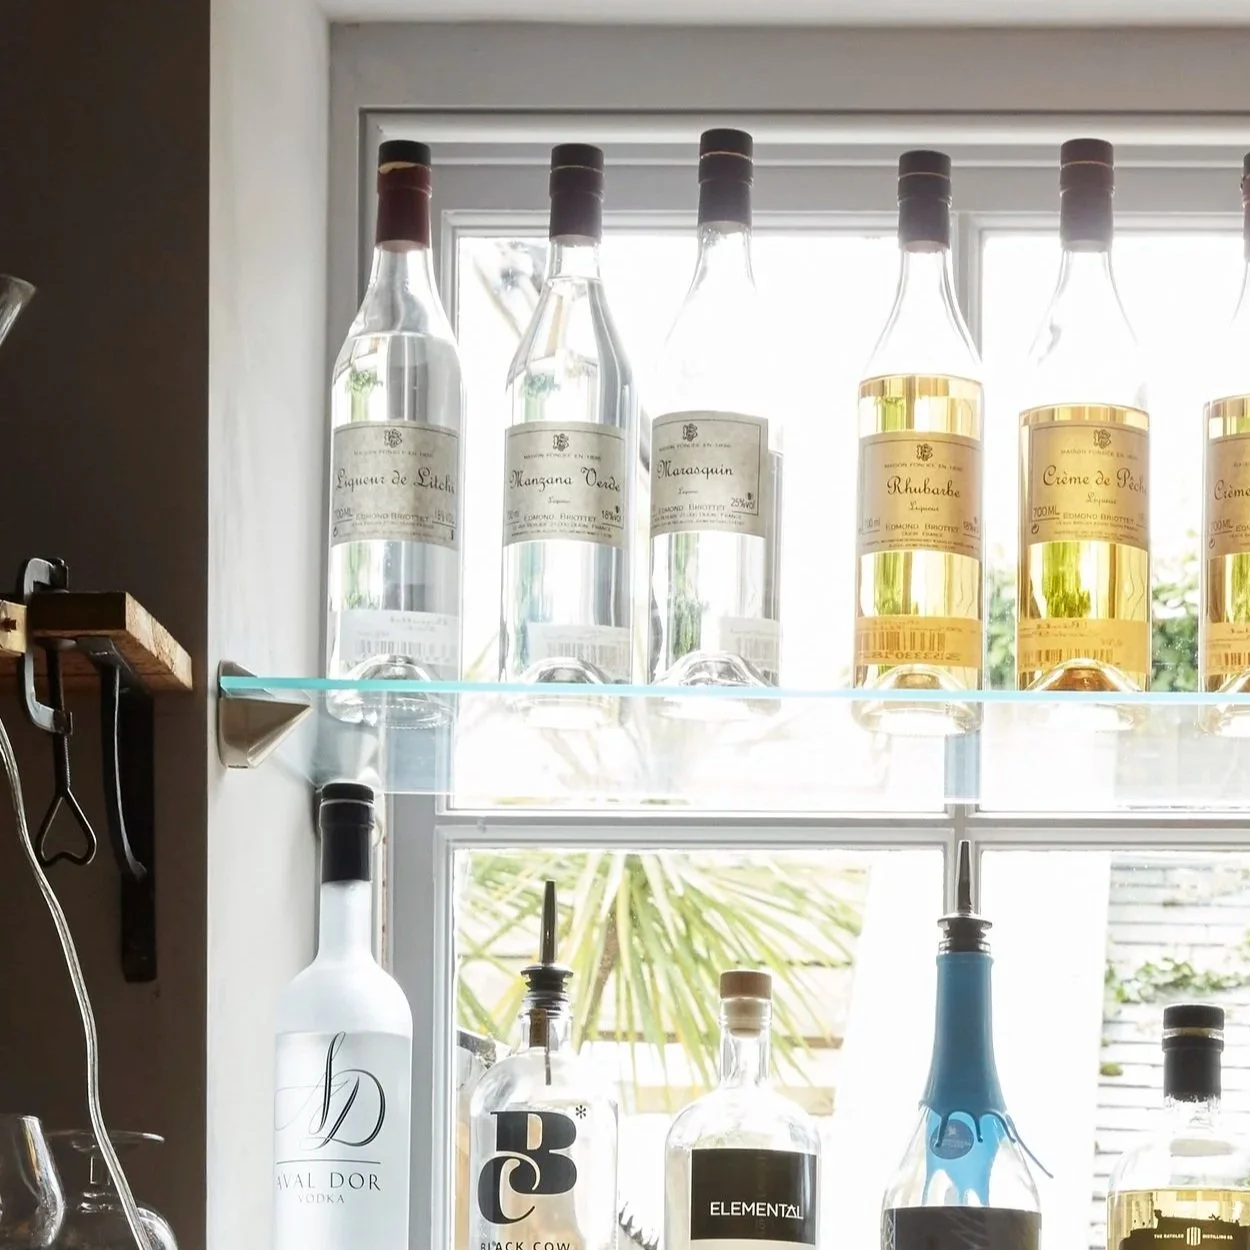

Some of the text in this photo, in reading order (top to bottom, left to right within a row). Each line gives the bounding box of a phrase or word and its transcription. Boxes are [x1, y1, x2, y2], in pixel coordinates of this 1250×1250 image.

[336, 468, 384, 492] Liqueur
[392, 470, 406, 485] de
[509, 466, 621, 493] Manzana Verde
[657, 459, 733, 480] Marasquin
[1042, 465, 1089, 486] Crème
[1095, 470, 1111, 486] de
[886, 475, 960, 498] Rhubarbe
[329, 1171, 381, 1191] DOR
[298, 1193, 345, 1204] VODKA
[709, 1201, 804, 1220] ELEMENTAL
